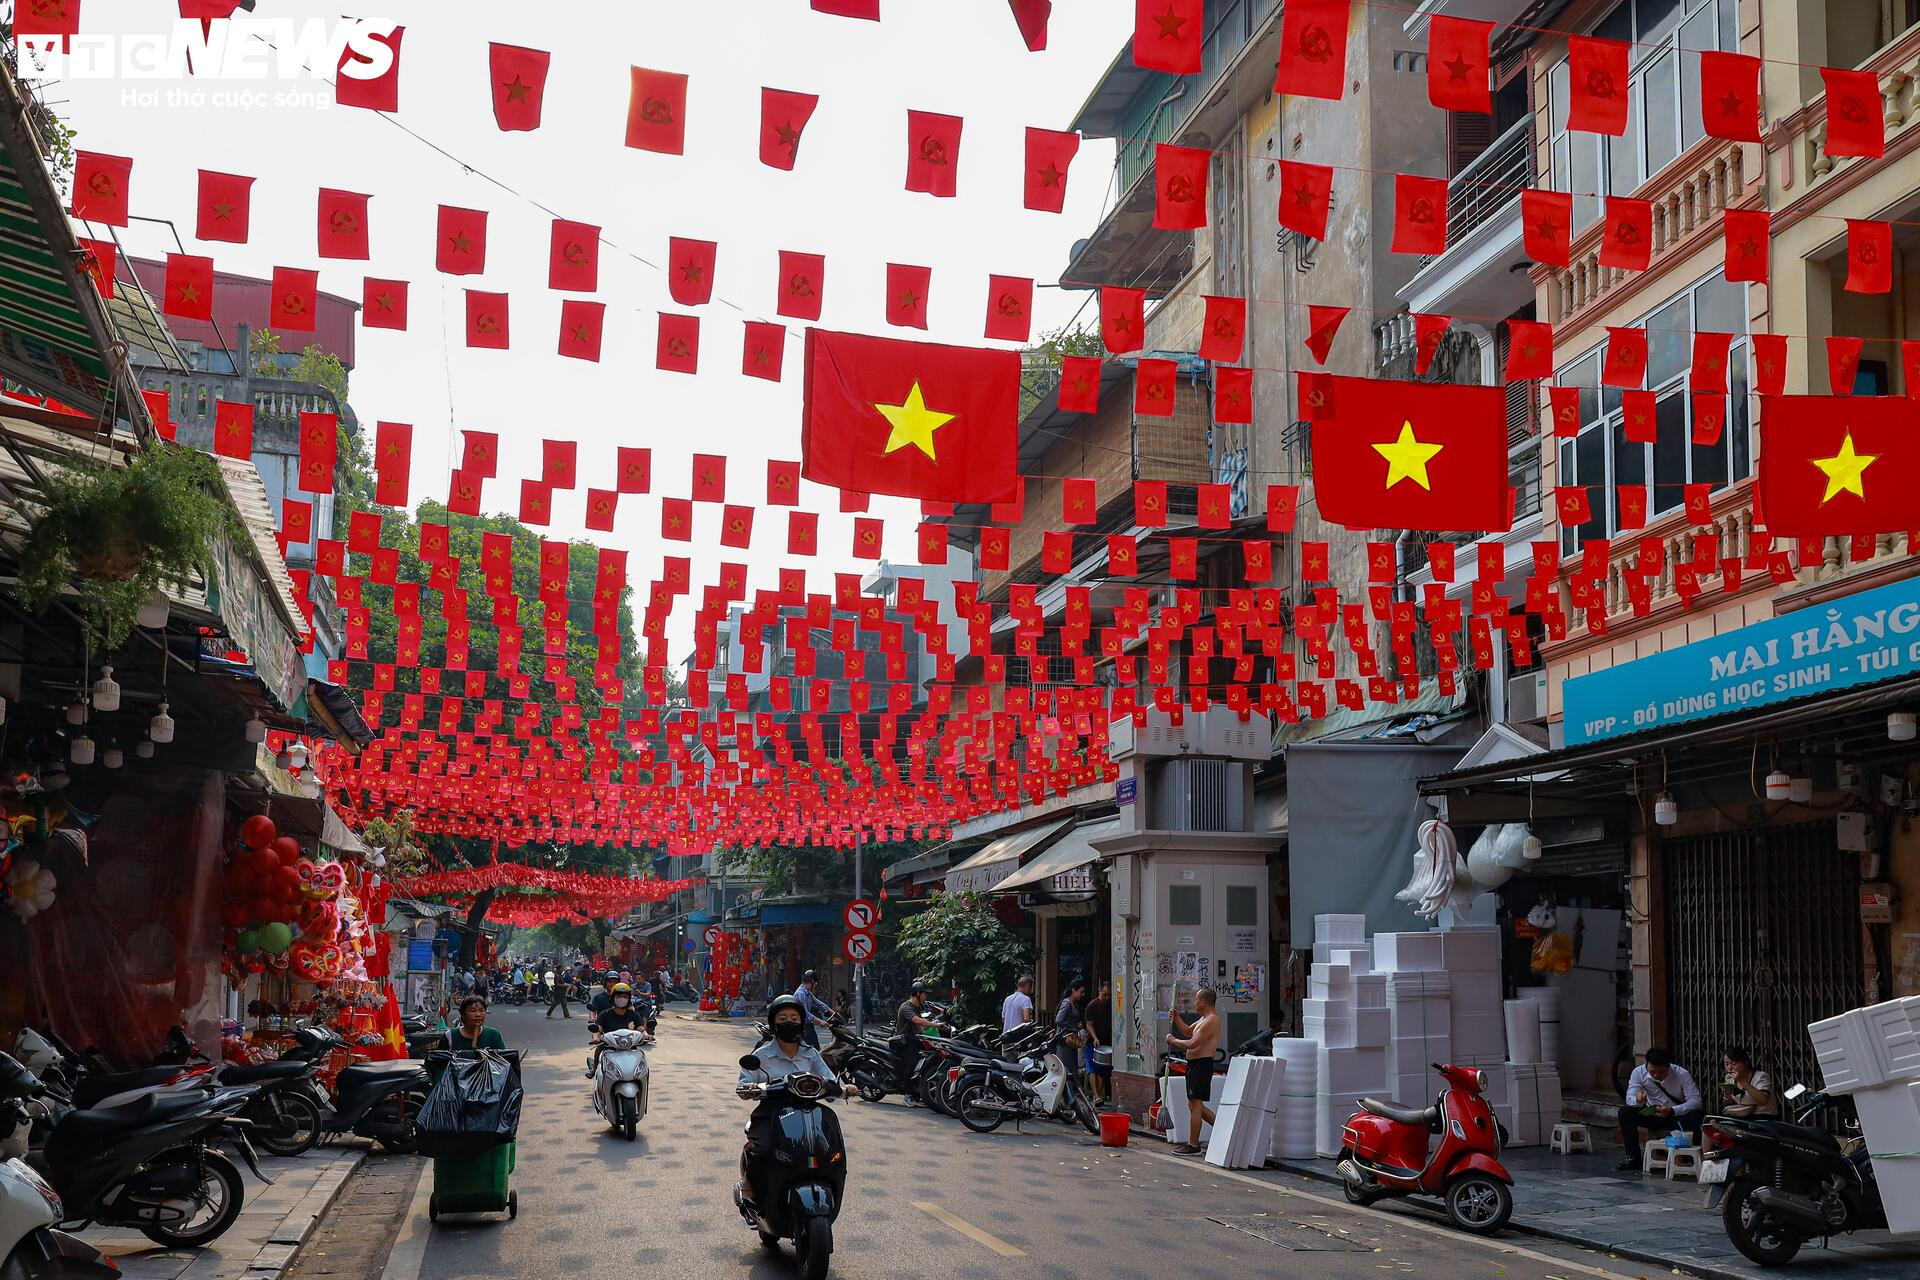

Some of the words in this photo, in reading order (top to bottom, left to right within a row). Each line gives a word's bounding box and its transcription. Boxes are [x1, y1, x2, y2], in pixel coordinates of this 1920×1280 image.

[1584, 716, 1616, 737] VPP
[1663, 692, 1716, 719] DÙNG
[1723, 679, 1766, 705] HỌC
[1773, 663, 1831, 693] SINH
[1856, 646, 1899, 673] TÚI
[1709, 639, 1780, 681] MAI
